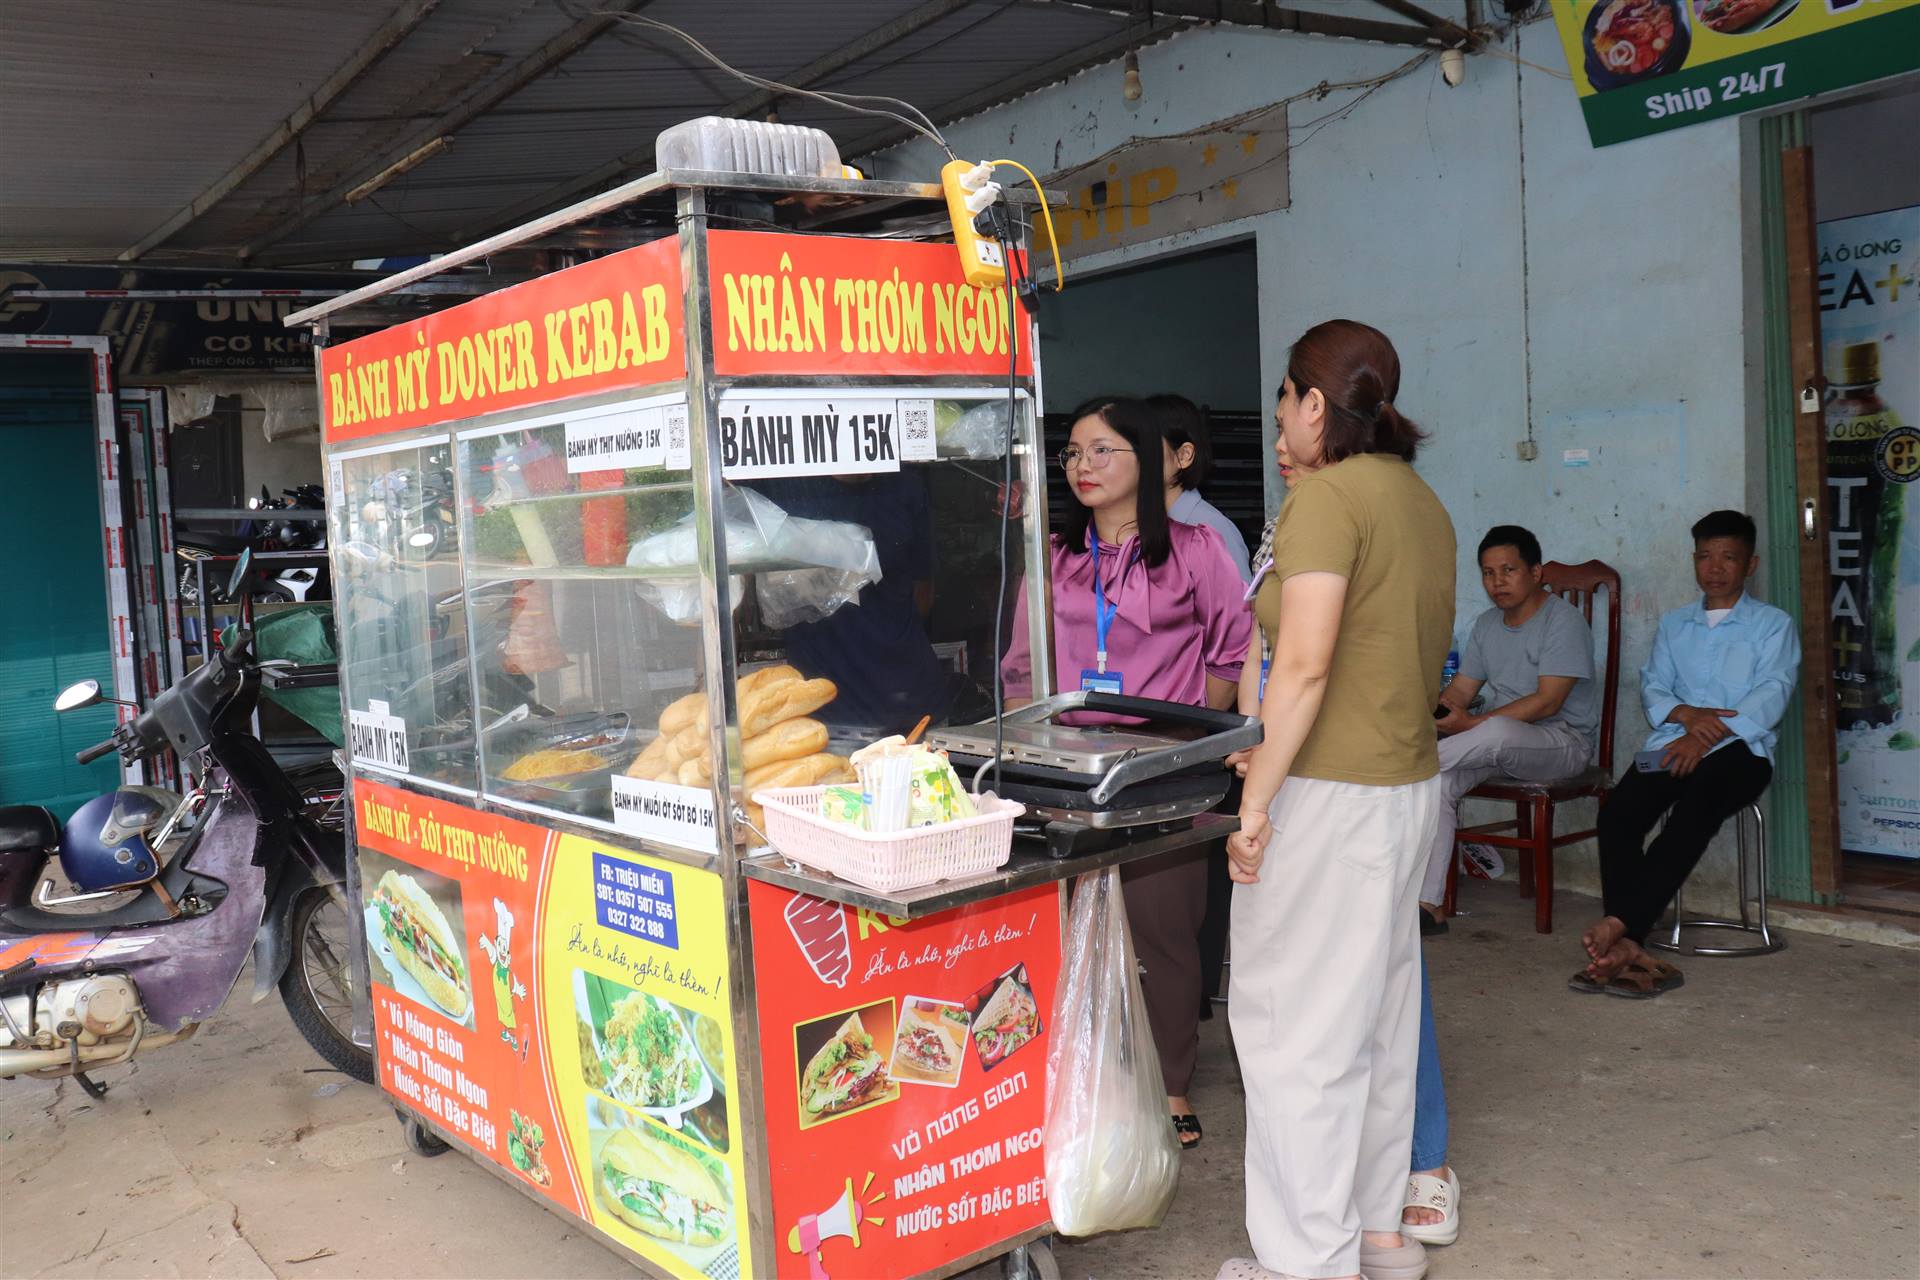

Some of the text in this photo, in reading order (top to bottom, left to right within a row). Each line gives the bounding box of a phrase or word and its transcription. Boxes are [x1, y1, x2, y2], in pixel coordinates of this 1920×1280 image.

[1645, 62, 1786, 119] Ship 24/7
[1854, 238, 1902, 259] LONG
[724, 251, 1018, 355] NHÂN THƠM NGON
[329, 283, 671, 427] BÁNH MỲ DONER KEBAB
[568, 428, 660, 459] BÁNH MỲ THỊT NƯỚNG 15K
[721, 404, 895, 467] BÁNH MỲ 15K
[1849, 419, 1888, 437] LONG
[352, 717, 407, 767] BÁNH MỲ 15K
[364, 794, 394, 838] BÁNH
[394, 804, 411, 844] MỲ
[419, 811, 442, 855] XÔI
[443, 824, 476, 872] THỊT
[477, 830, 528, 882] NƯỚNG
[699, 807, 713, 828] 15K
[601, 863, 614, 881] FB:
[615, 867, 639, 891] TRIỆU
[615, 889, 635, 909] 0357
[637, 895, 653, 914] 507
[655, 900, 673, 920] 555
[607, 907, 665, 939] 0327 322 888
[567, 923, 590, 953] Ăn
[592, 937, 604, 958] là
[664, 961, 676, 983] là
[680, 969, 709, 995] thèm
[861, 947, 894, 983] Ăn
[897, 951, 911, 970] là
[978, 930, 991, 948] là
[994, 924, 1023, 943] thèm
[389, 1001, 464, 1063] Vỏ Nóng Giòn
[392, 1034, 488, 1110] Nhân Thơm Ngon
[394, 1065, 496, 1151] Nước Sốt Đặc Biệt
[894, 1164, 946, 1200] NHÂN
[950, 1142, 1001, 1179] THƠM
[896, 1176, 1047, 1238] NƯỚC SỐT ĐẶC BIỆT
